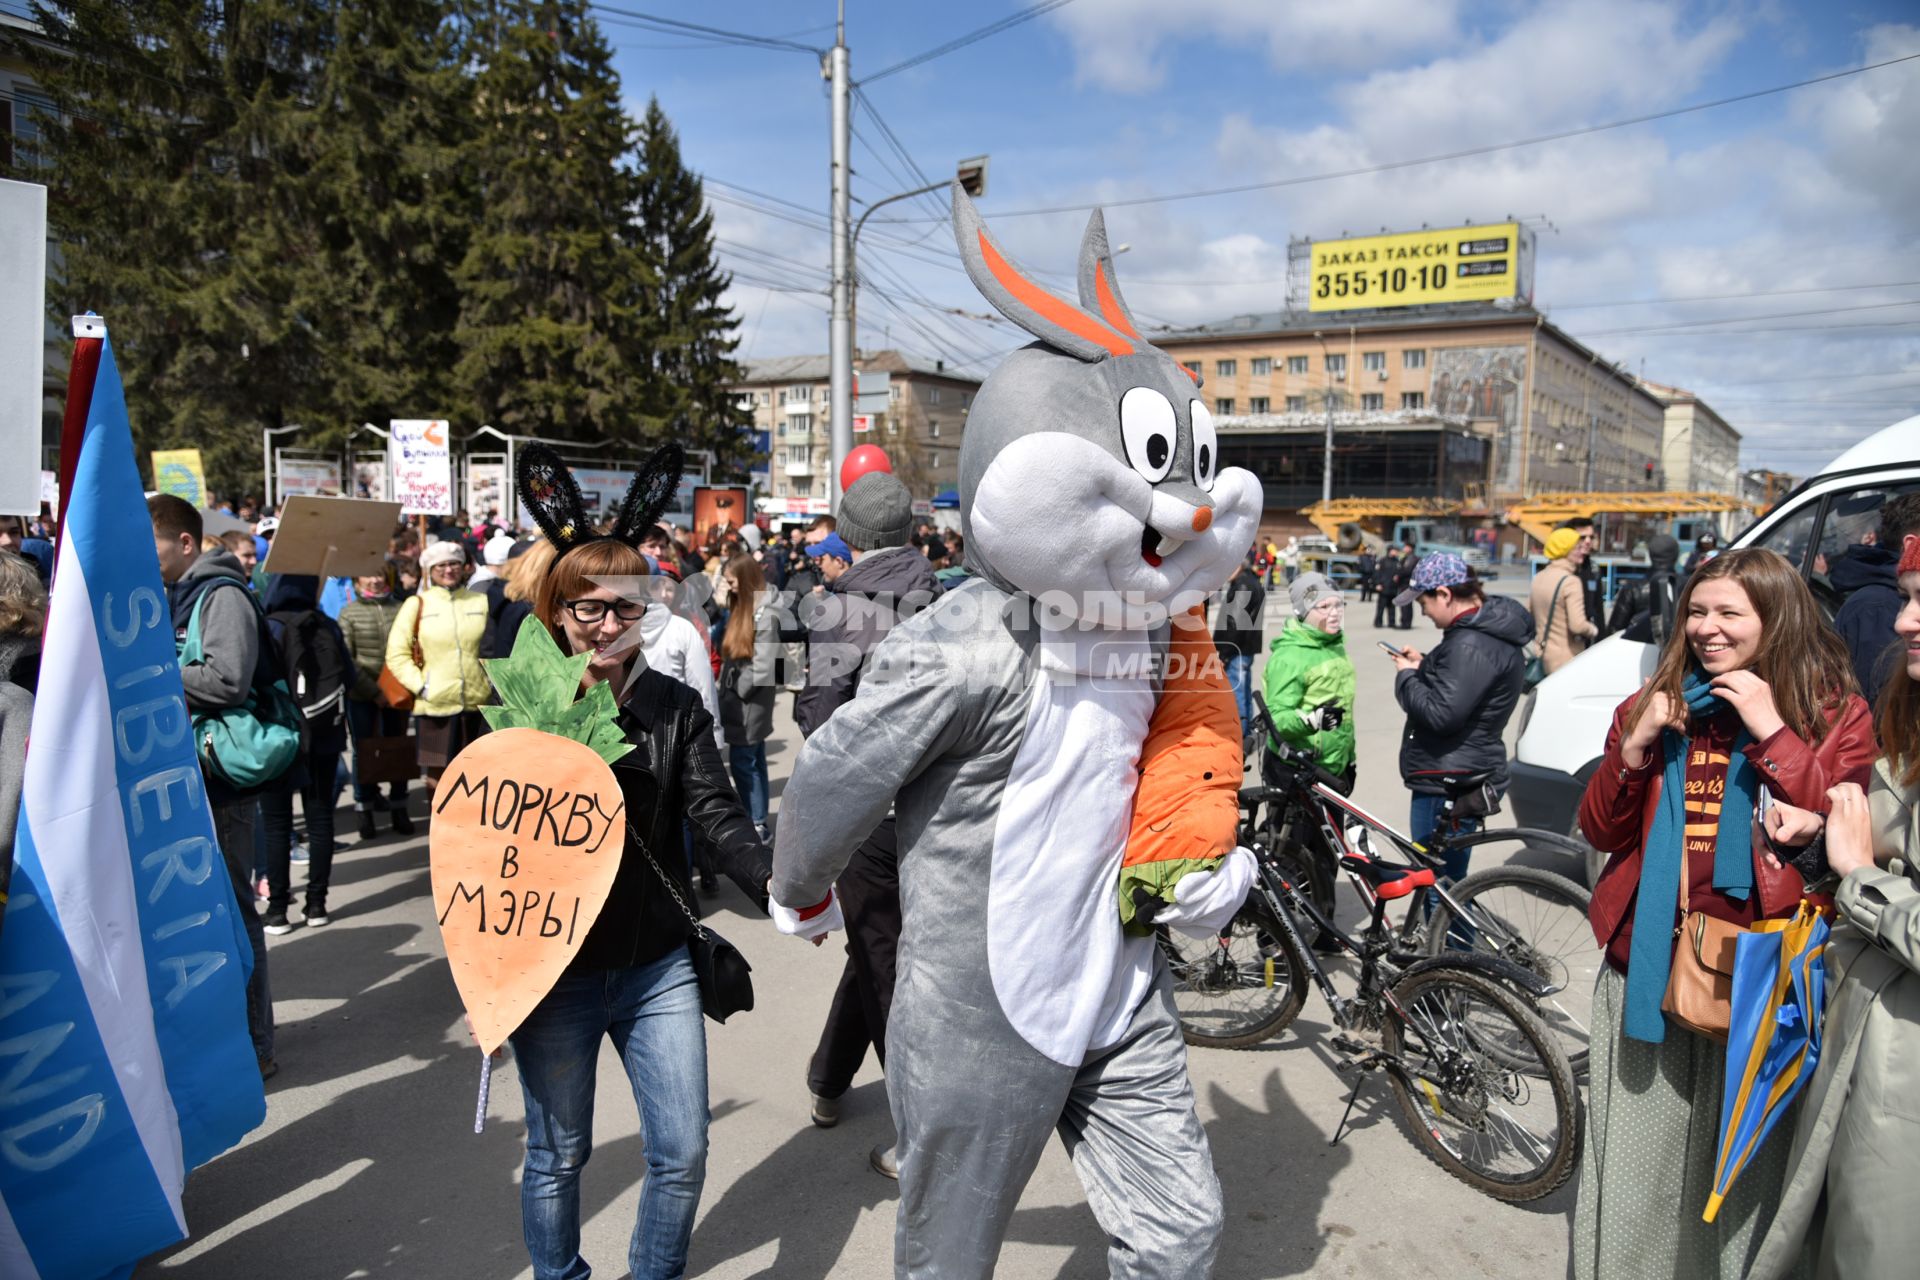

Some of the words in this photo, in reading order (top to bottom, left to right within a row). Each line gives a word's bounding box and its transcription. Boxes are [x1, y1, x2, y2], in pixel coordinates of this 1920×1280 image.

[1318, 249, 1378, 267] ЗАКАЗ
[1386, 243, 1449, 260] ТАКСИ
[436, 771, 624, 854] МОРКВУ
[500, 845, 519, 879] В
[438, 881, 581, 945] МЭРЫ
